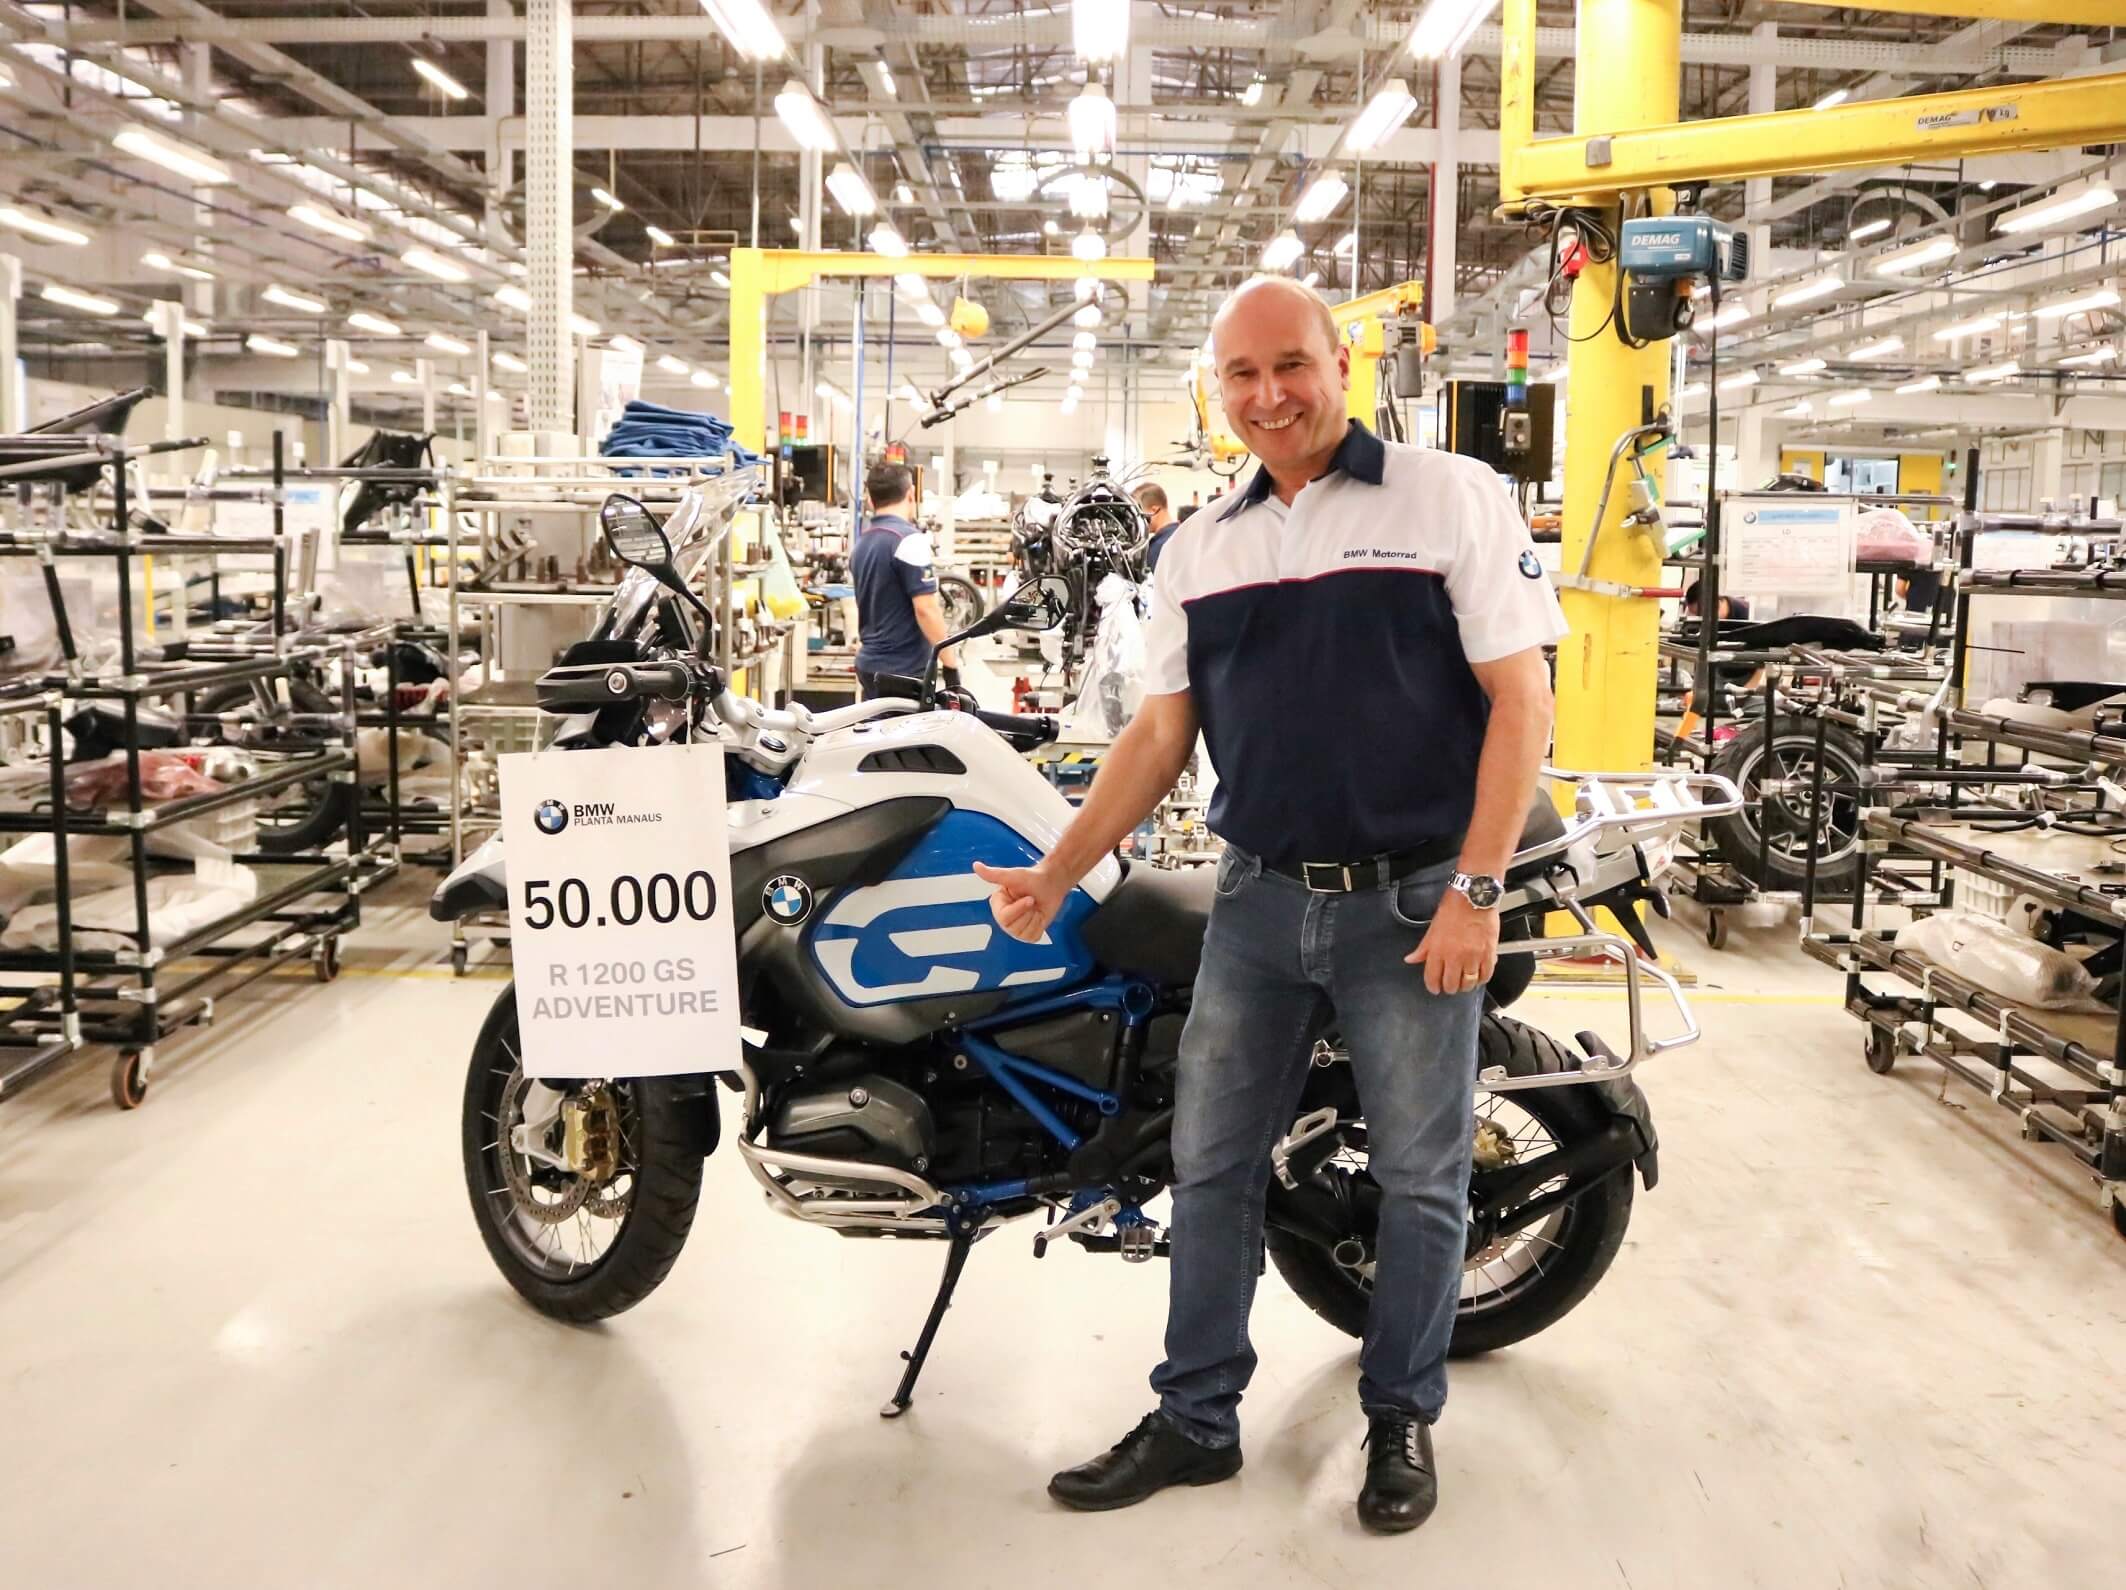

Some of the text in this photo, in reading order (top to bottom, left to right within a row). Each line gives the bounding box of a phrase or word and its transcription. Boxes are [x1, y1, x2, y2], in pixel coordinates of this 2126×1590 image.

[1632, 234, 1680, 246] DEMAG
[1343, 548, 1417, 560] BMW Motorrad
[574, 803, 615, 818] BMW
[574, 813, 663, 826] PLANTA MANAUS
[524, 870, 717, 930] 50.000
[550, 957, 696, 986] R 1200 GS
[532, 990, 719, 1019] ADVENTURE
